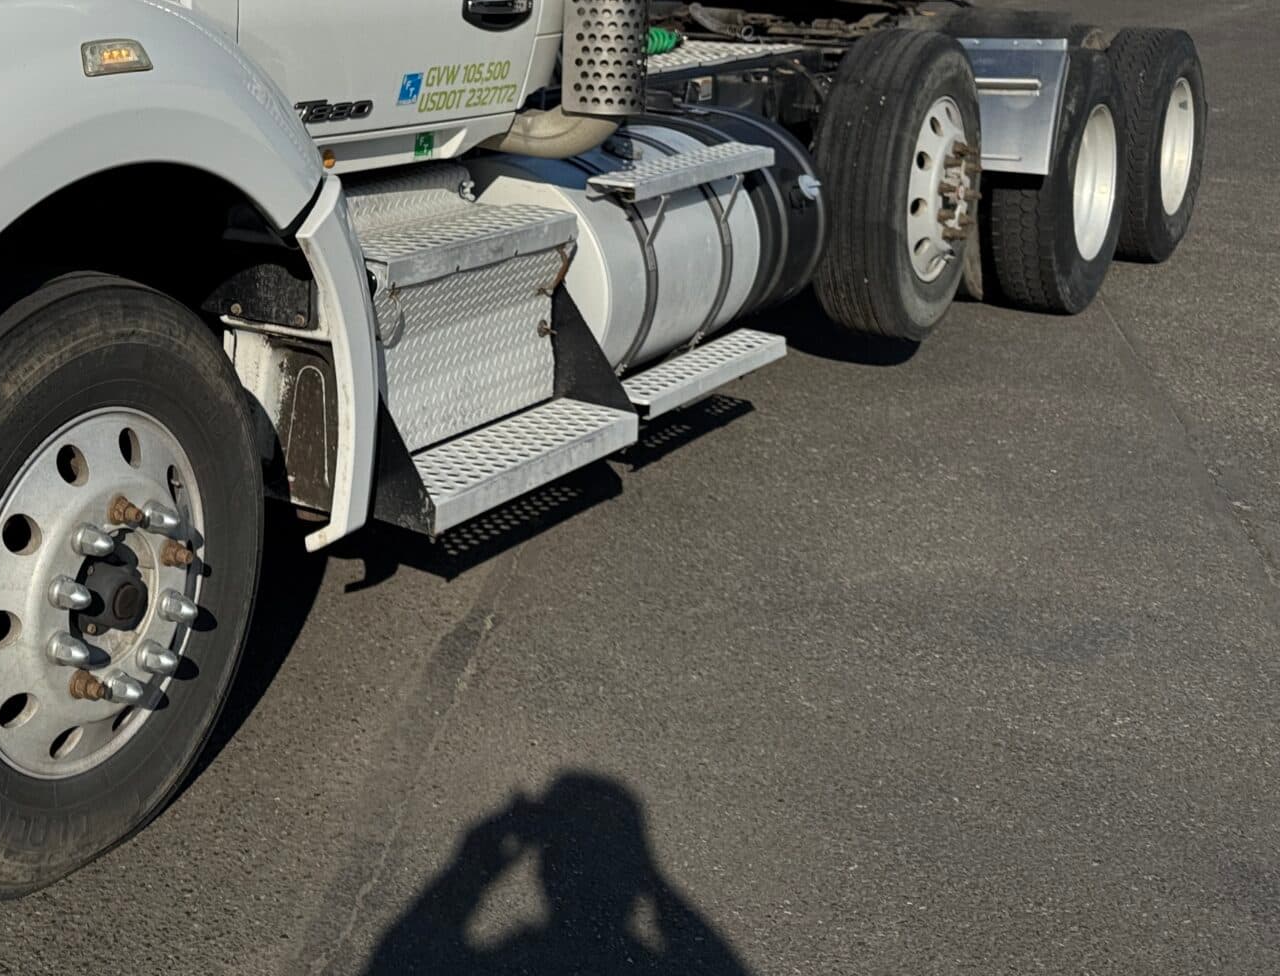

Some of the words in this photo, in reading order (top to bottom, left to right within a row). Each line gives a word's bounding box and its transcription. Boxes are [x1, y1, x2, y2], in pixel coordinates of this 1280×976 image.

[425, 64, 461, 87] GVW
[462, 60, 511, 85] 105,500
[294, 99, 373, 124] T880
[418, 88, 466, 113] USDOT
[465, 84, 517, 108] 2327172
